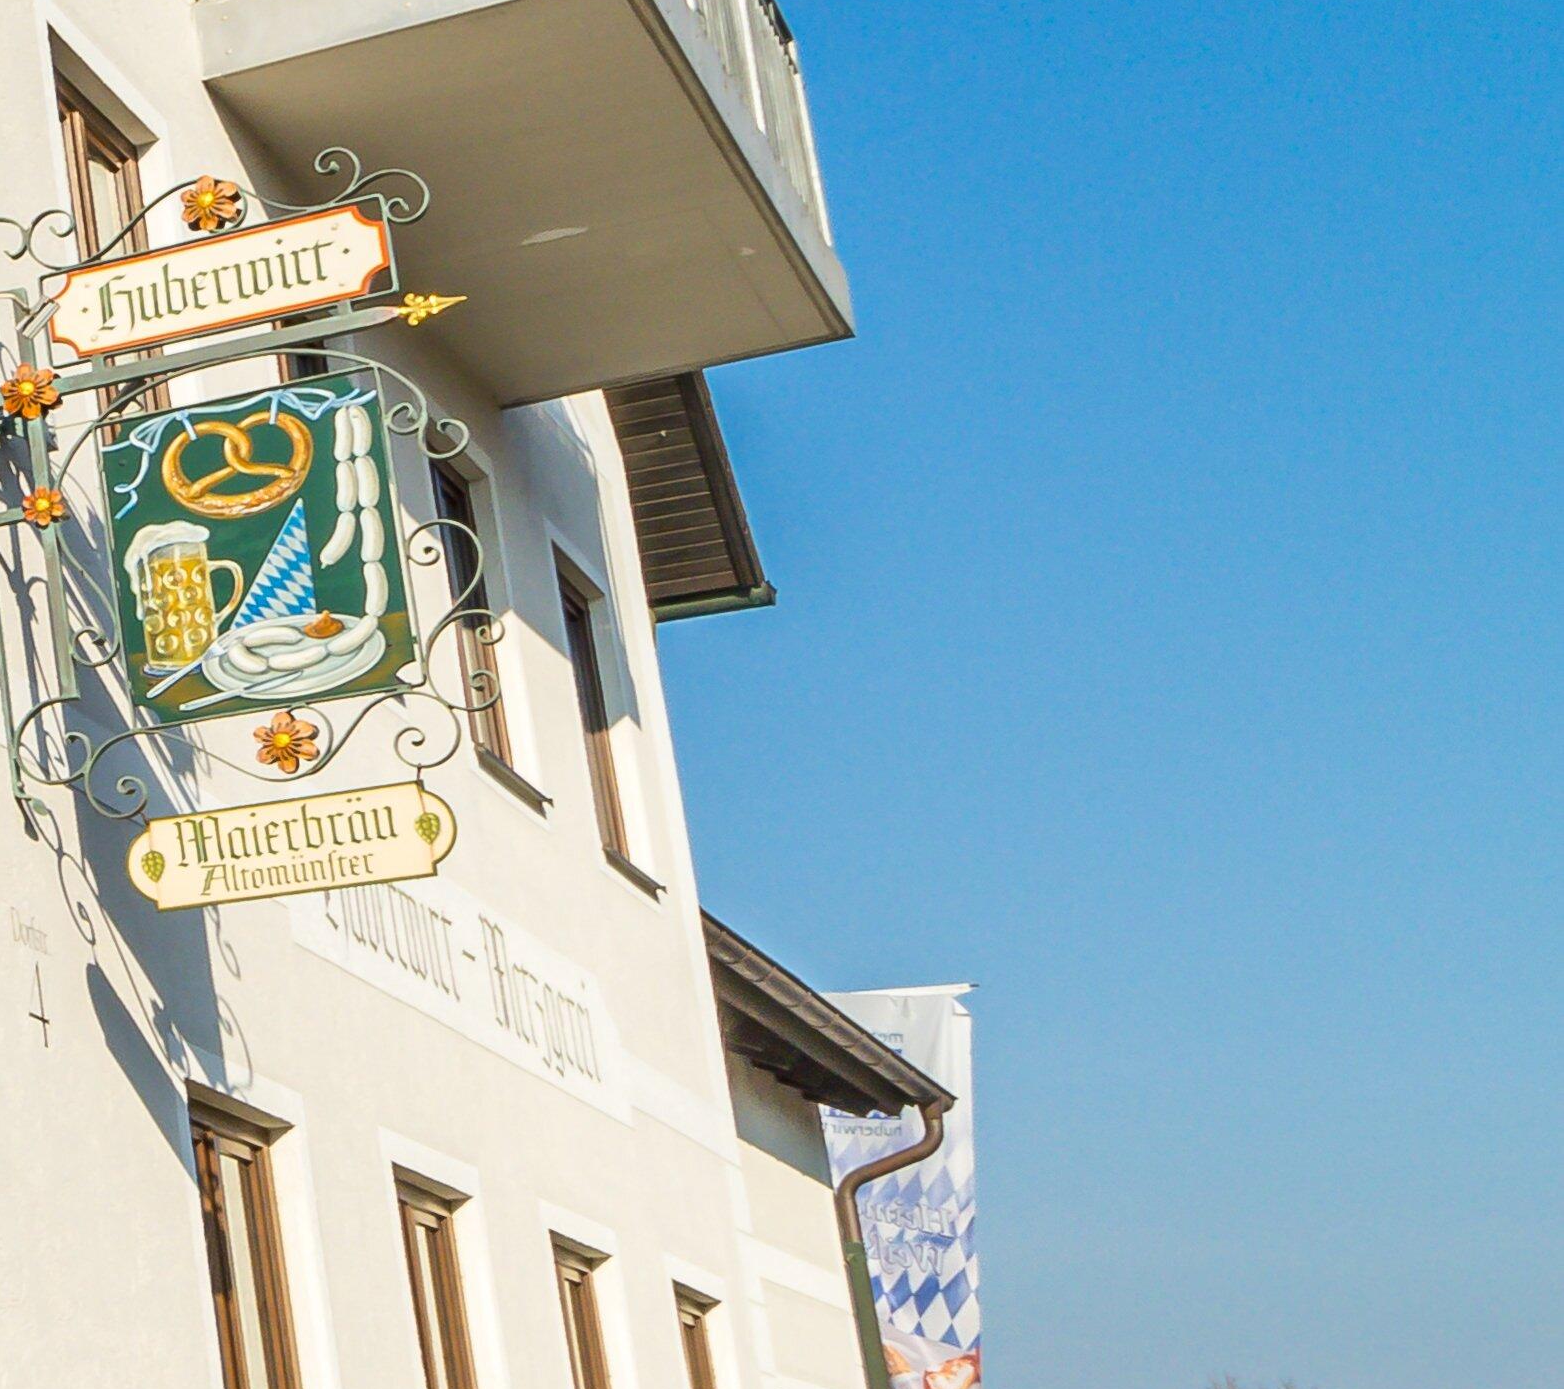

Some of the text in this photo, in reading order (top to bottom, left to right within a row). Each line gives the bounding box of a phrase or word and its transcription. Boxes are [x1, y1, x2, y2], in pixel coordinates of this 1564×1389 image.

[97, 238, 334, 333] Huberwirt
[173, 796, 399, 868] Maierbräu
[29, 960, 50, 1048] 4
